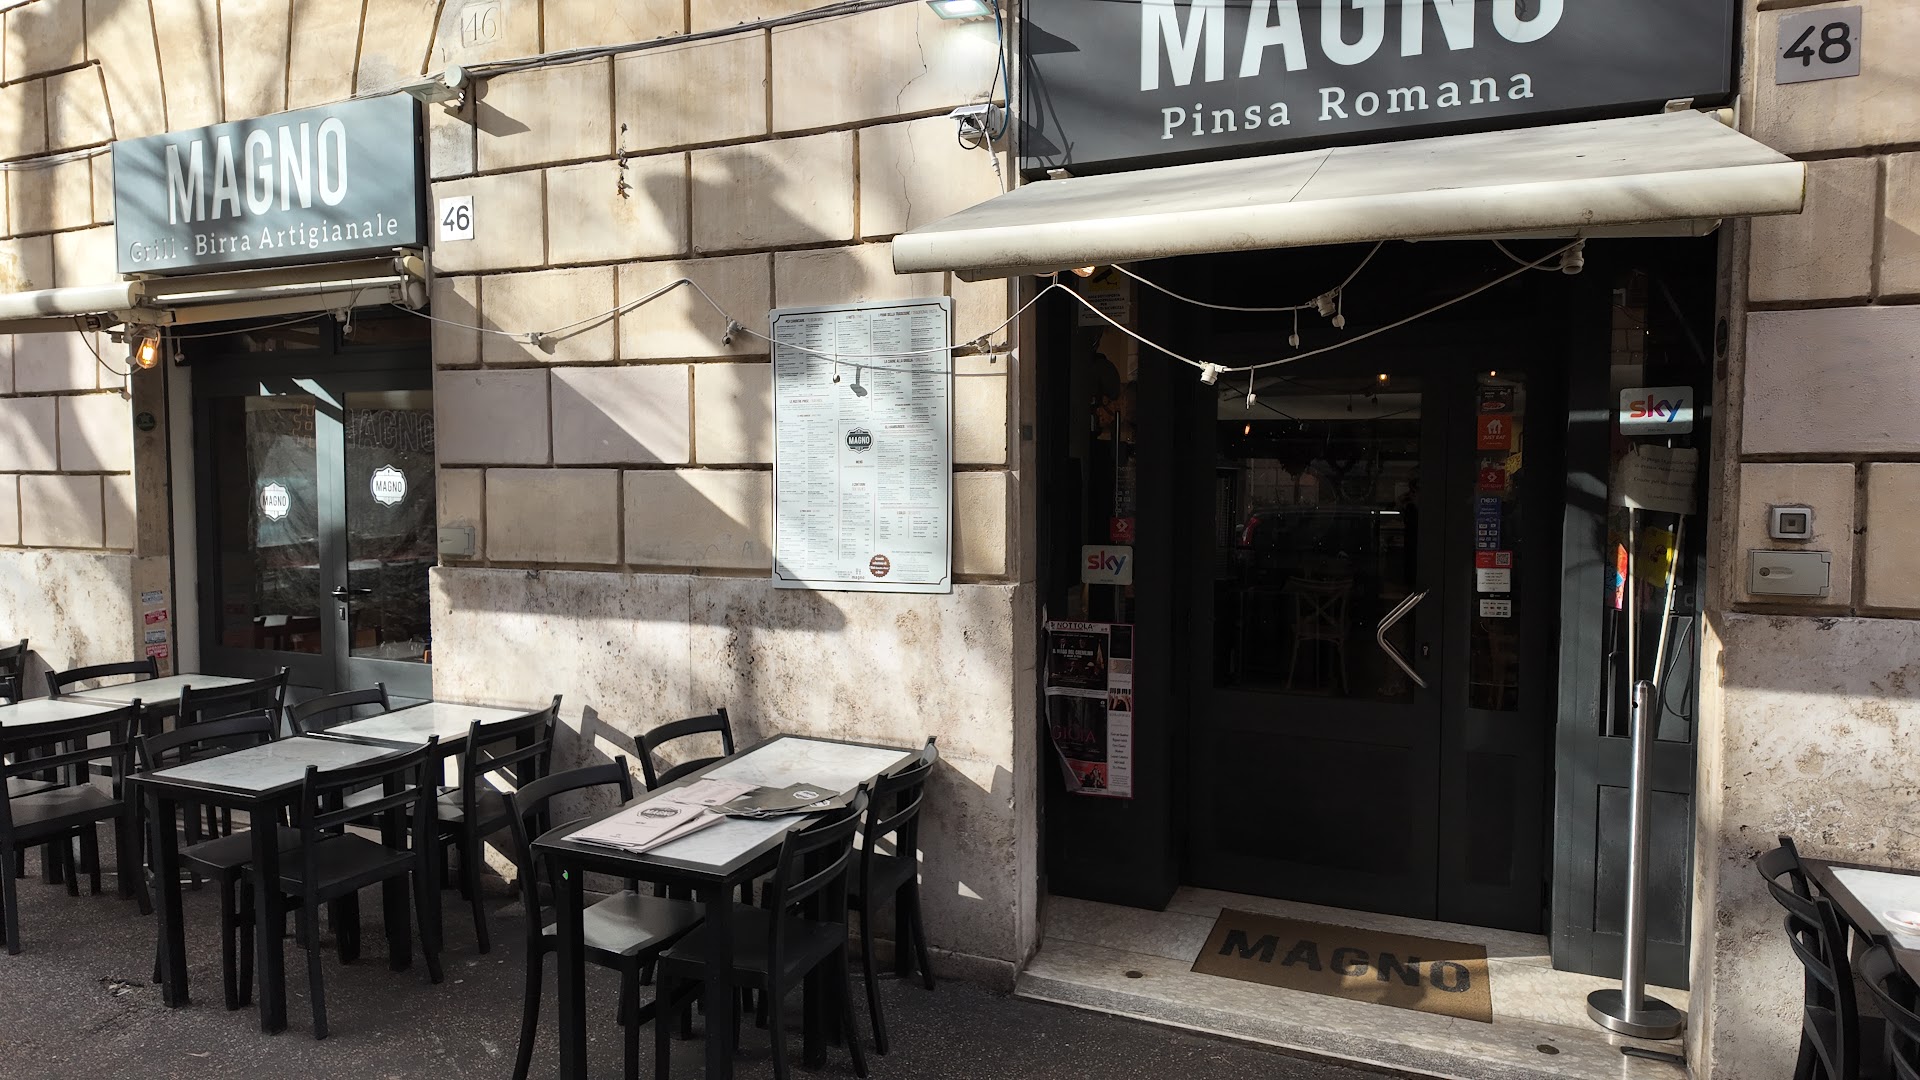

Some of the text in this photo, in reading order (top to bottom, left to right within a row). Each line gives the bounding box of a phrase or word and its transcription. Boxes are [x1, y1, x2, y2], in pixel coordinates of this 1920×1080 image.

[464, 7, 498, 41] 46
[1783, 21, 1851, 66] 48
[1160, 73, 1534, 140] Pinsa Romana
[166, 117, 347, 225] MAGNO
[442, 205, 470, 231] 46
[129, 237, 177, 263] Grill
[195, 232, 251, 256] Birra
[258, 213, 399, 250] Artigianale
[1629, 394, 1684, 423] sky
[848, 436, 870, 445] MAGNO
[262, 495, 287, 507] MAGNO
[375, 480, 403, 493] MAGNO
[1087, 550, 1127, 576] sky
[1218, 929, 1471, 993] MAGNO
